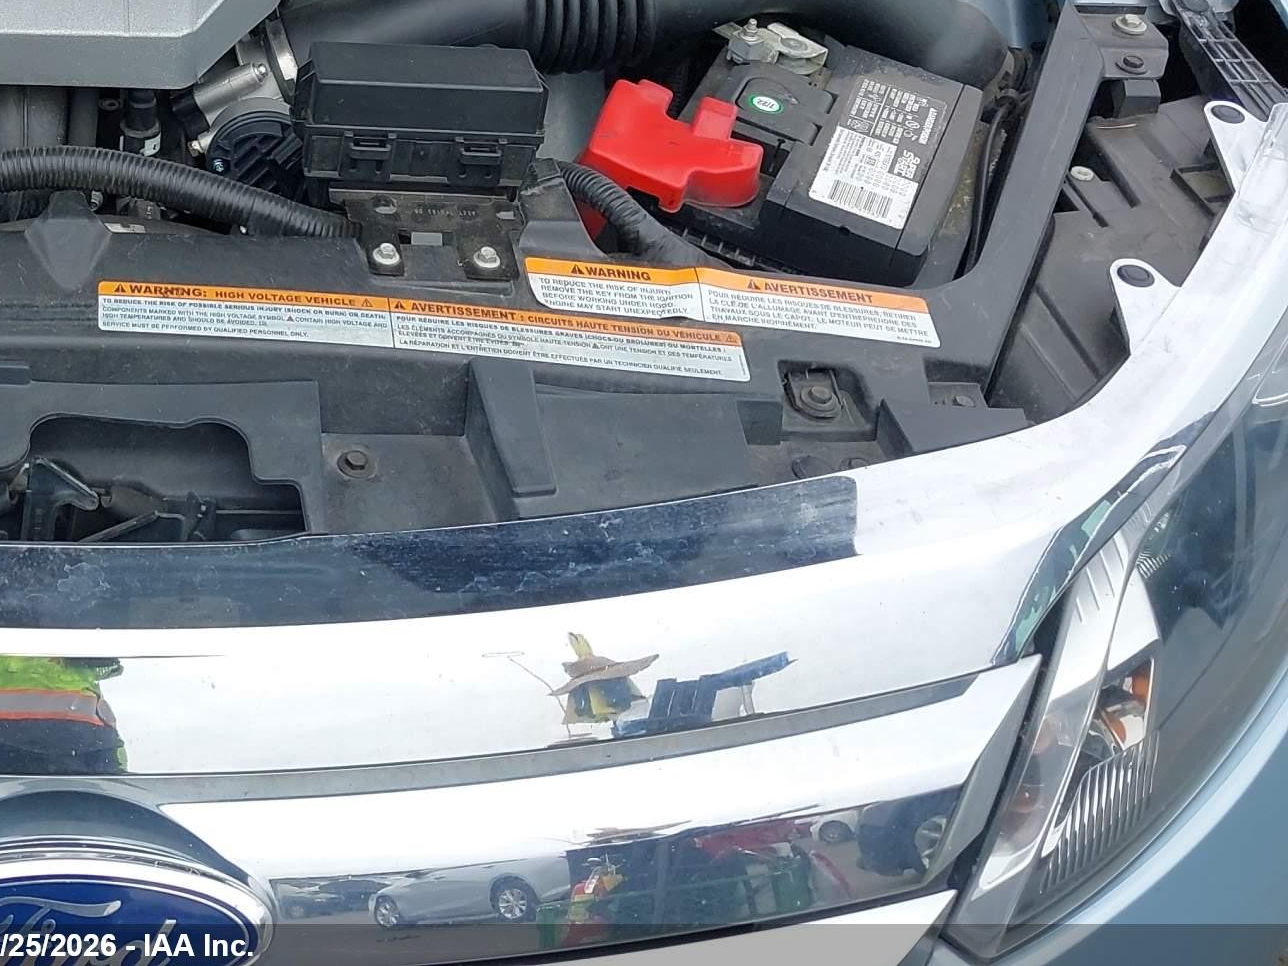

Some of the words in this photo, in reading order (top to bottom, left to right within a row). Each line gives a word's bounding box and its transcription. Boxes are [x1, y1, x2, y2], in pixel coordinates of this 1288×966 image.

[585, 267, 651, 281] WARNING
[129, 285, 207, 297] WARNING:
[215, 291, 244, 299] HIGH
[248, 293, 302, 303] VOLTAGE
[305, 296, 356, 306] VEHICLE
[541, 285, 575, 294] REMOVE
[614, 292, 638, 300] FROM
[764, 281, 873, 304] AVERTISSEMENT
[543, 293, 576, 301] BEFORE
[578, 296, 617, 305] WORKING
[619, 299, 648, 308] UNDER
[596, 305, 621, 313] START
[411, 302, 516, 321] AVERTISSEMENT
[527, 316, 574, 327] CIRCUITS
[576, 320, 609, 331] HAUTE
[612, 324, 654, 335] TENSION
[656, 328, 670, 337] DU
